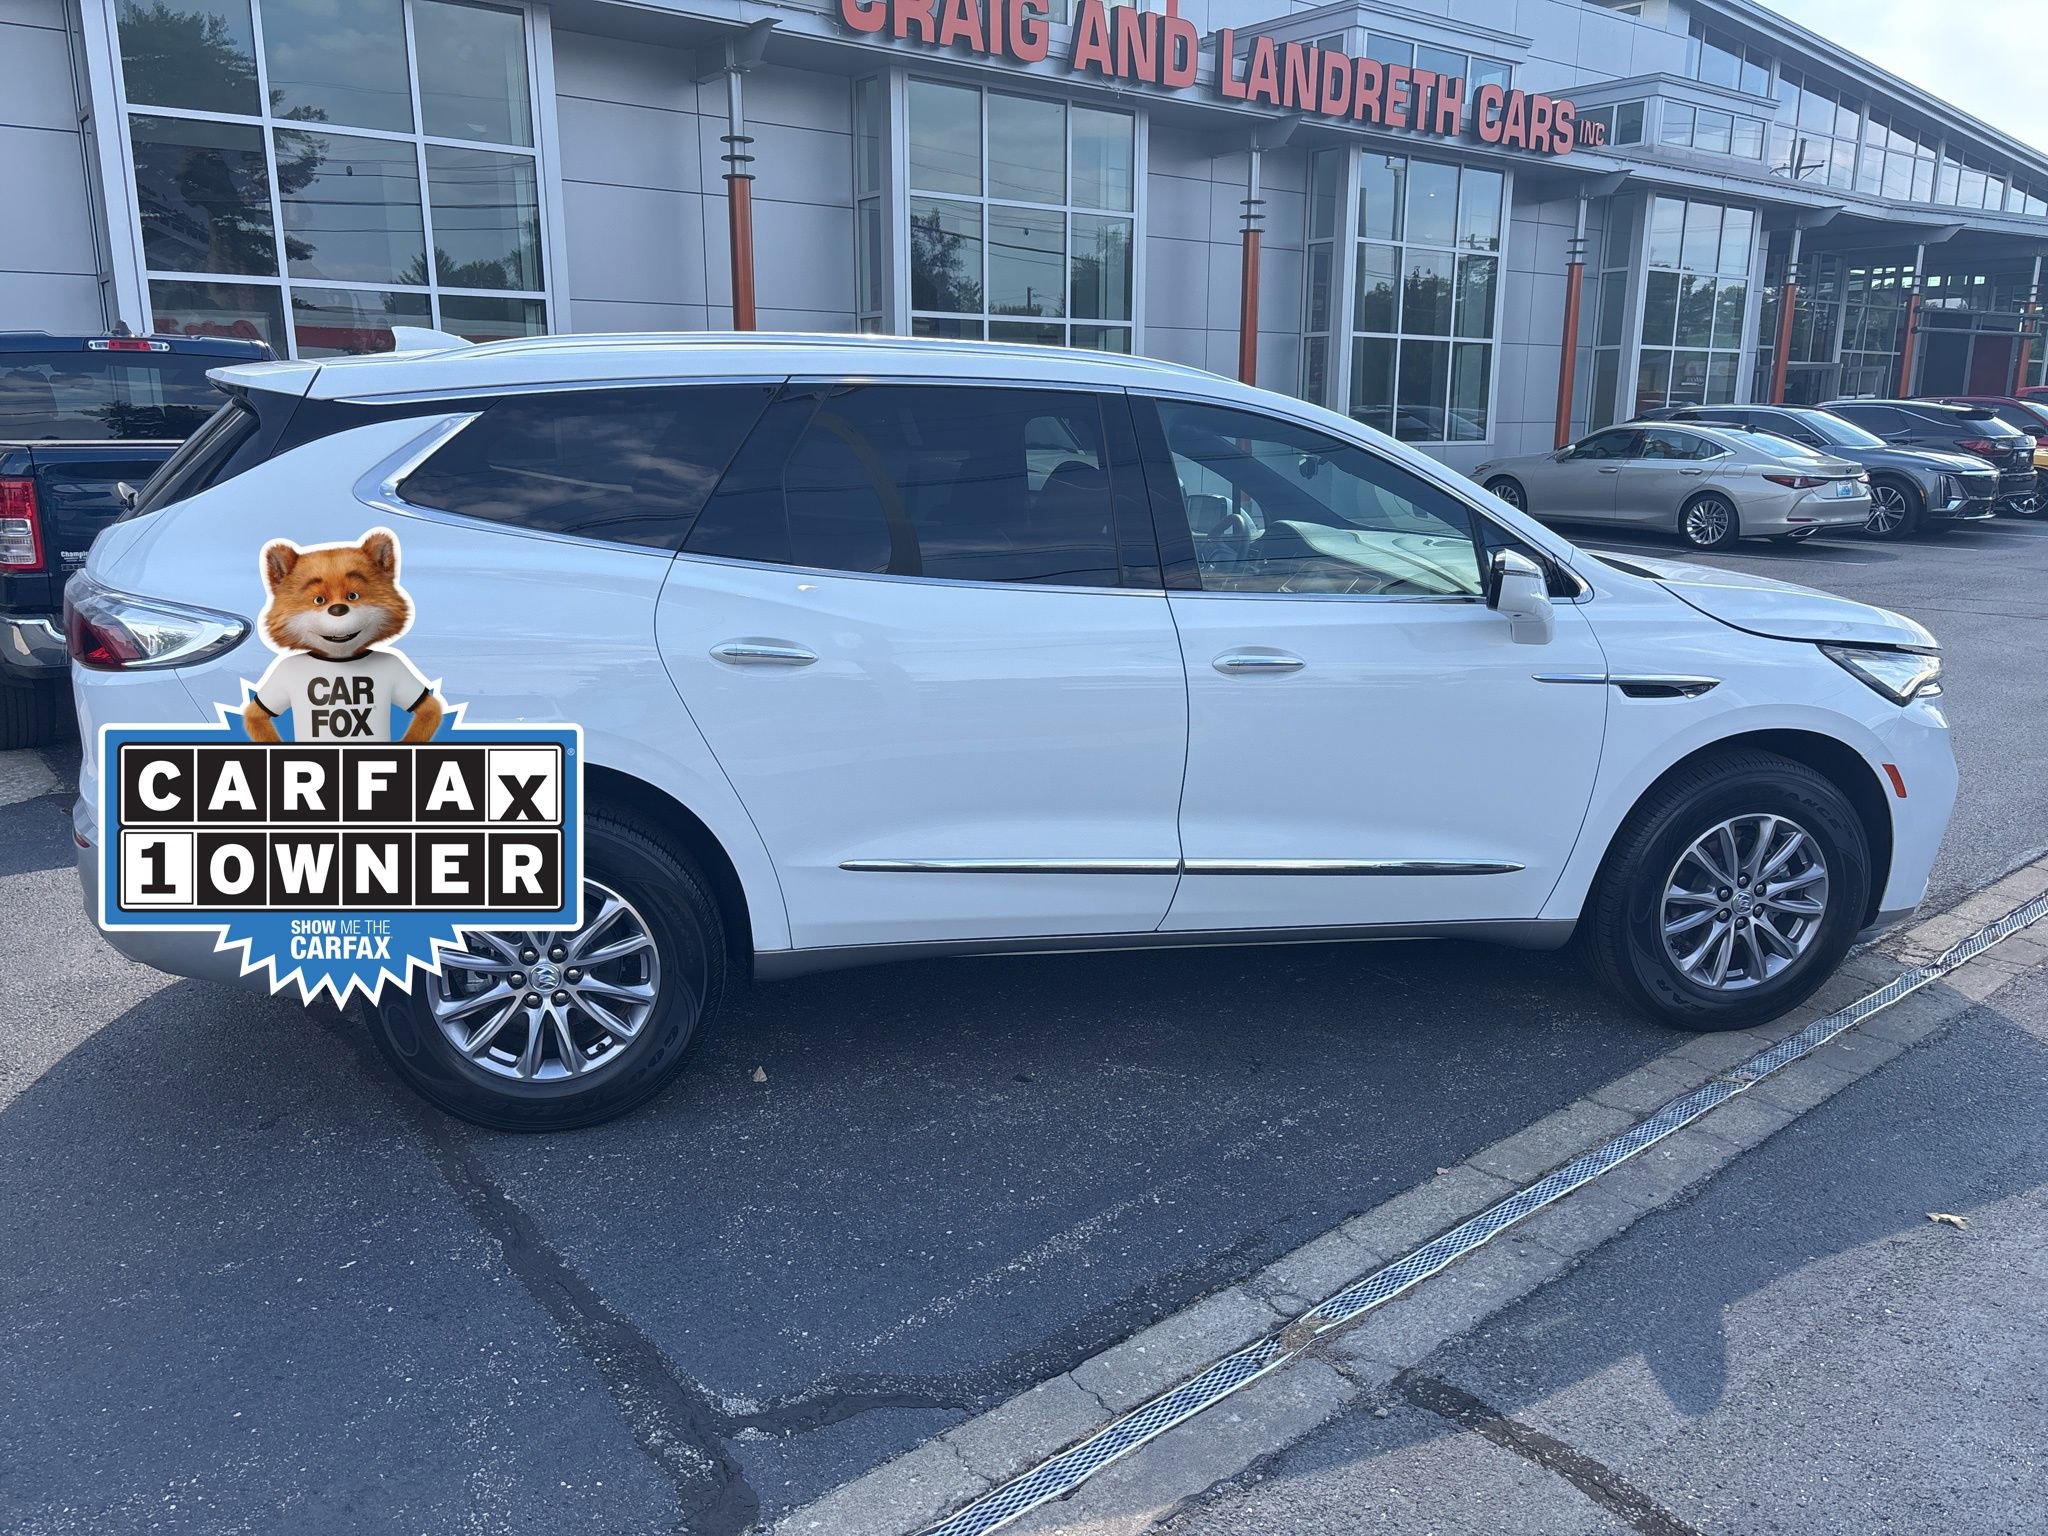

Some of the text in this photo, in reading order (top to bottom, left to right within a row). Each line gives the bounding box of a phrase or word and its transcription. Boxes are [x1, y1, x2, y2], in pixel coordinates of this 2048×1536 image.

[1072, 0, 1199, 88] AND
[1218, 28, 1464, 136] LANDRETH
[1477, 84, 1576, 155] CARS
[1579, 120, 1606, 146] INC
